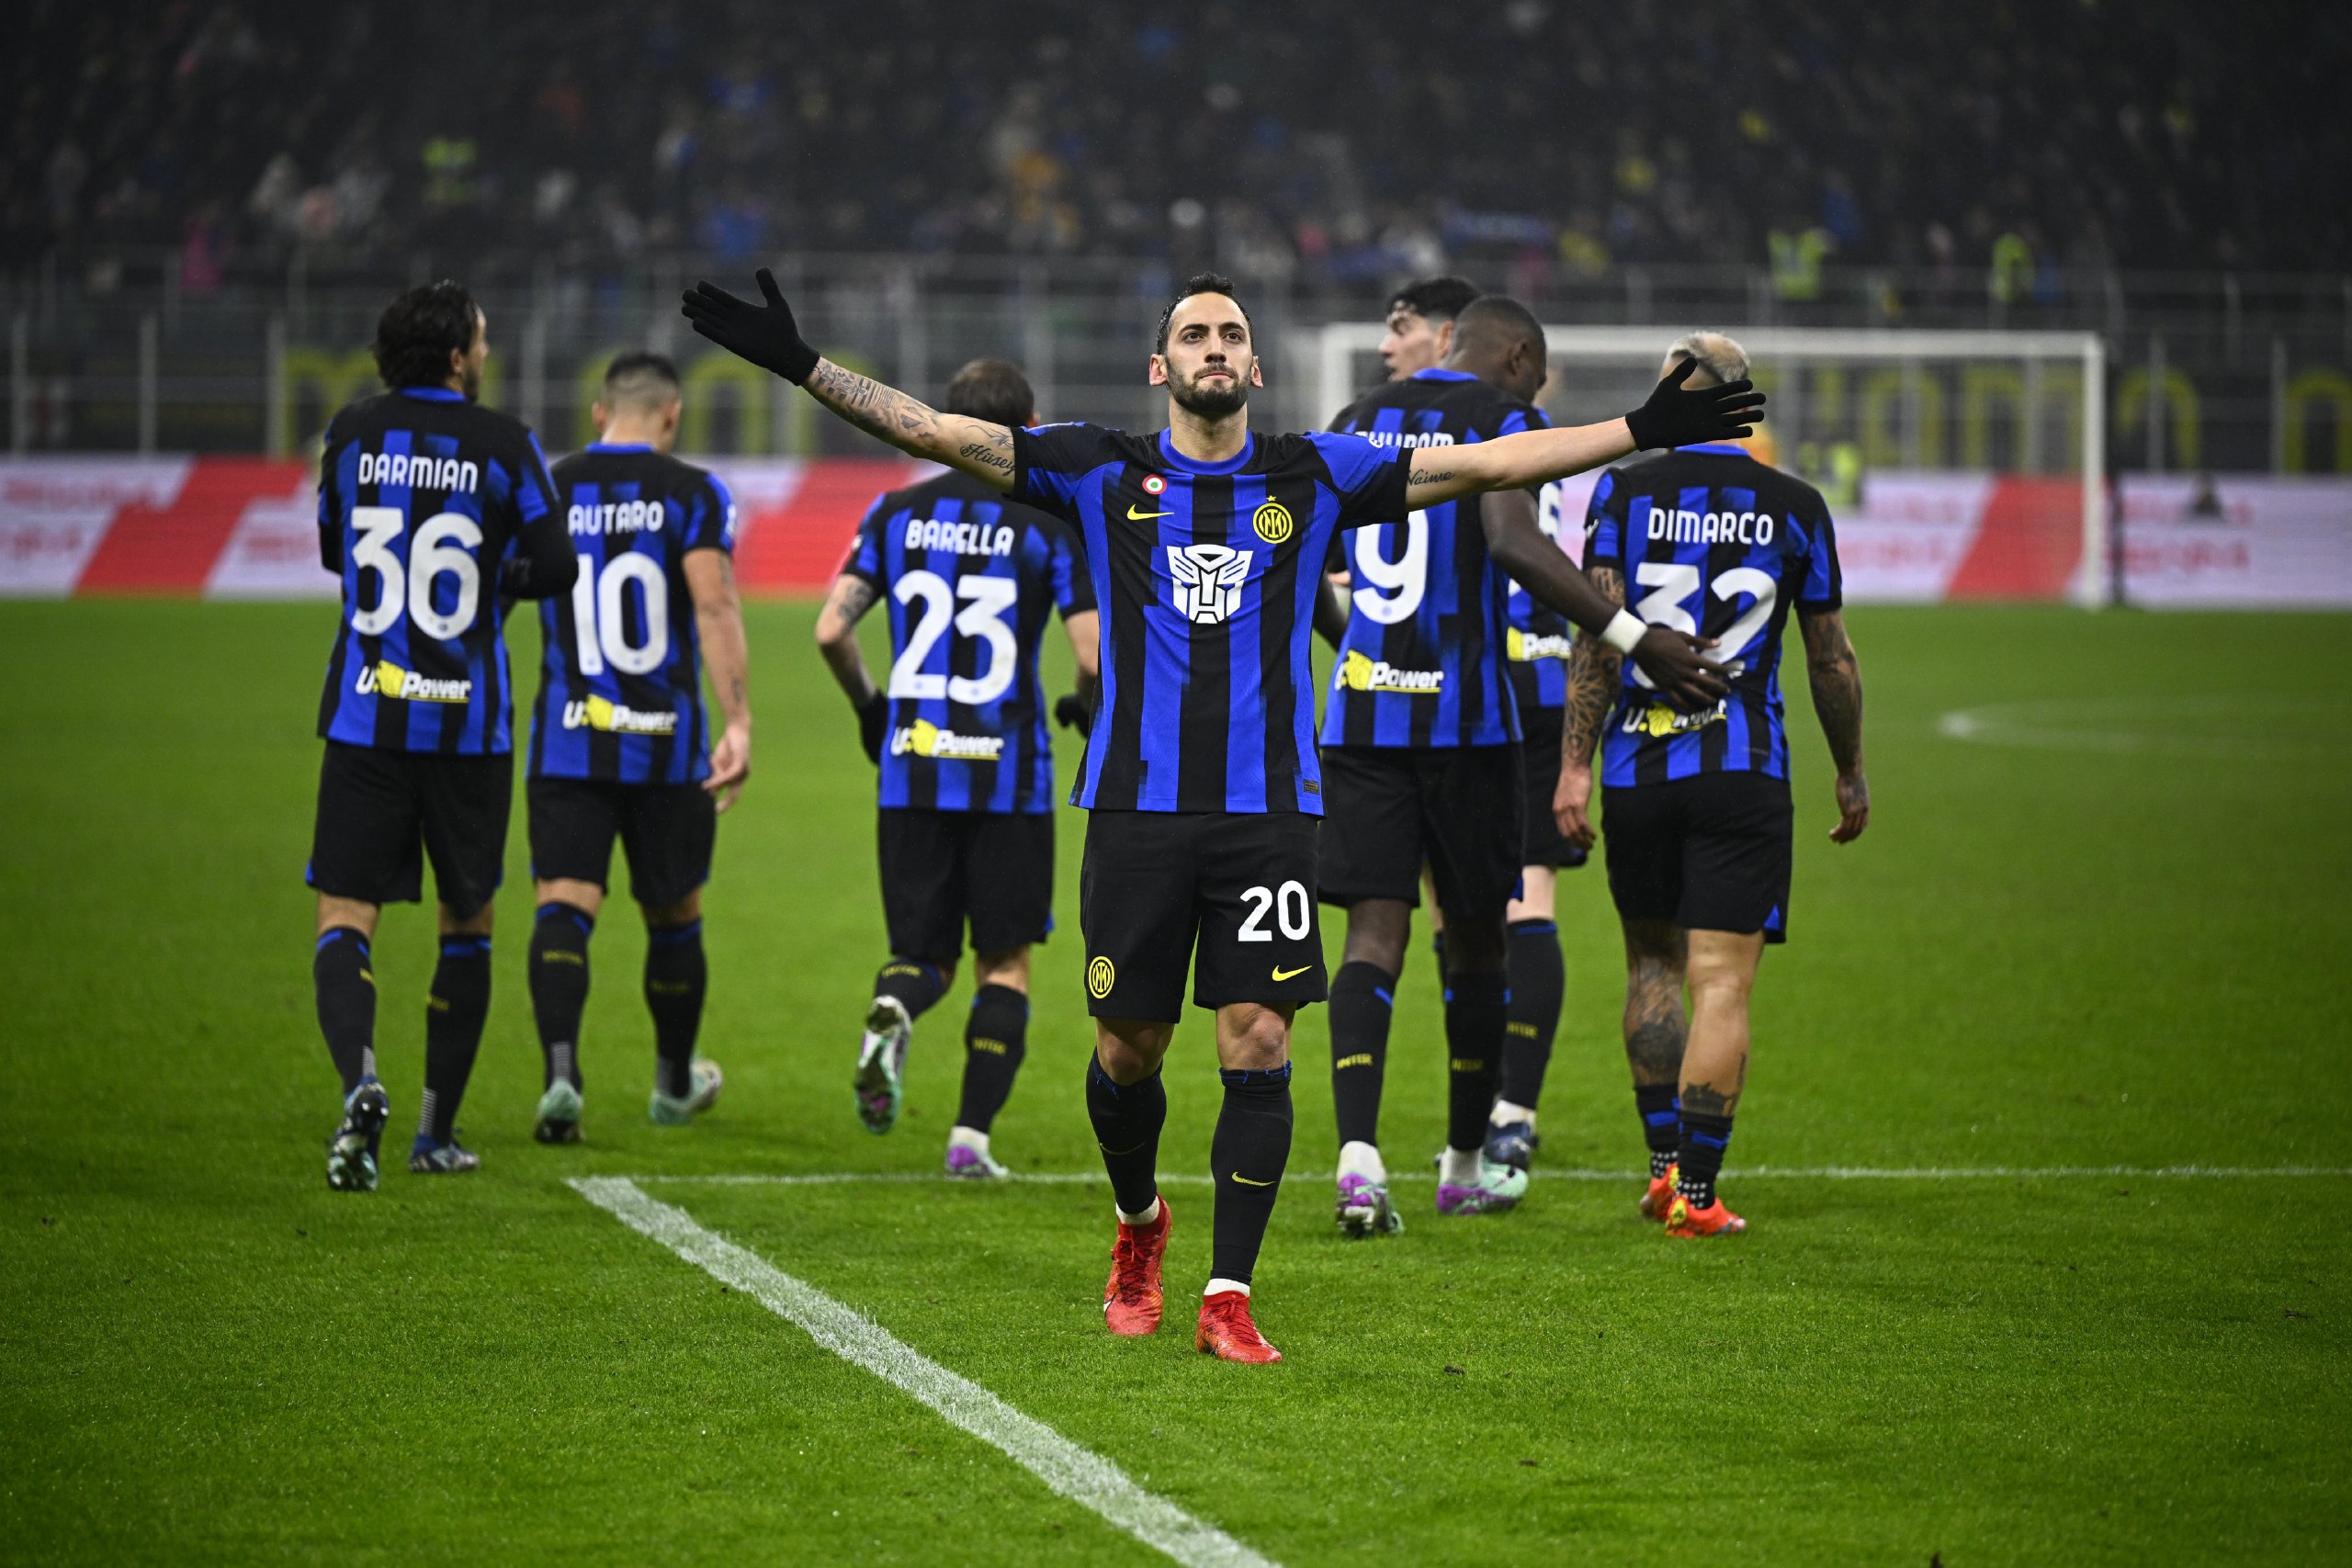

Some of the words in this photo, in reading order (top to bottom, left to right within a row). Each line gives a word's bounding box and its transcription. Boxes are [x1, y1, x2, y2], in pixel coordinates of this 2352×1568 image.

[358, 453, 478, 494] DARMIAN
[959, 443, 1015, 477] Hüsey
[567, 500, 665, 536] AUTARO
[904, 518, 1015, 557] BARELLA
[1647, 506, 1774, 547] DIMARCO
[351, 506, 483, 640] 36
[1352, 508, 1429, 625] 9
[571, 551, 668, 676] 10
[1630, 562, 1777, 689] 32
[887, 569, 1017, 705] 23
[399, 671, 472, 700] Power
[1367, 661, 1444, 691] Power
[1238, 880, 1310, 942] 20
